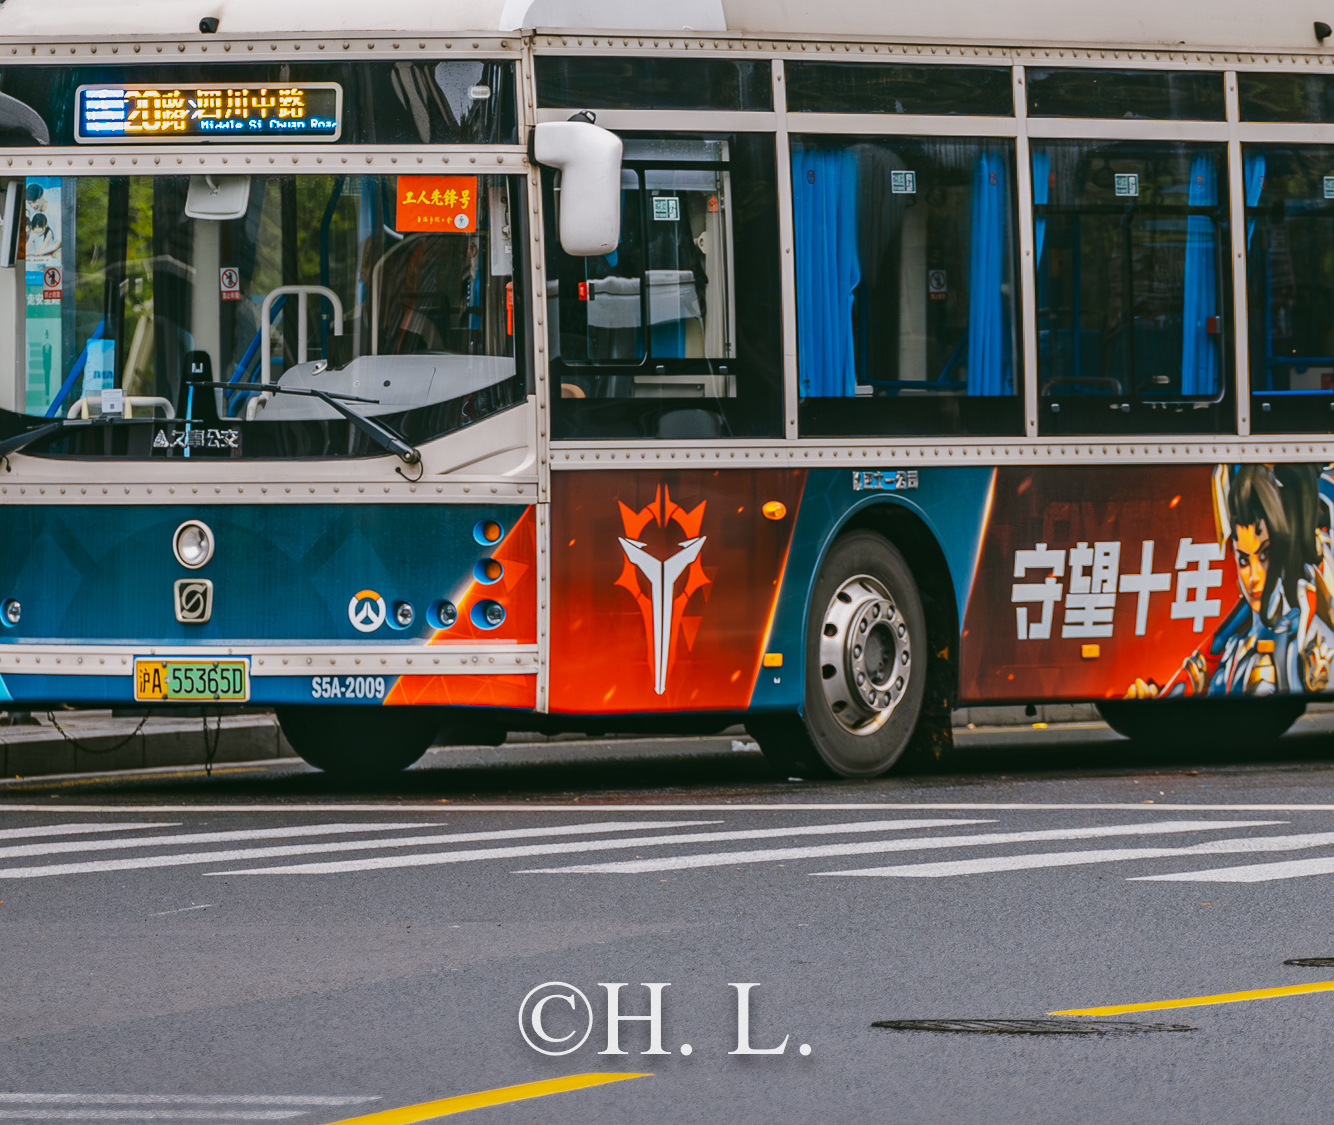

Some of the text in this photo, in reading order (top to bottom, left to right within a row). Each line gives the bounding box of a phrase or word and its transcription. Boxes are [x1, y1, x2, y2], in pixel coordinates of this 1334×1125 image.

[402, 188, 471, 210] 工人先锋号
[1011, 537, 1225, 641] 守望十年
[311, 676, 386, 699] S5A-2009
